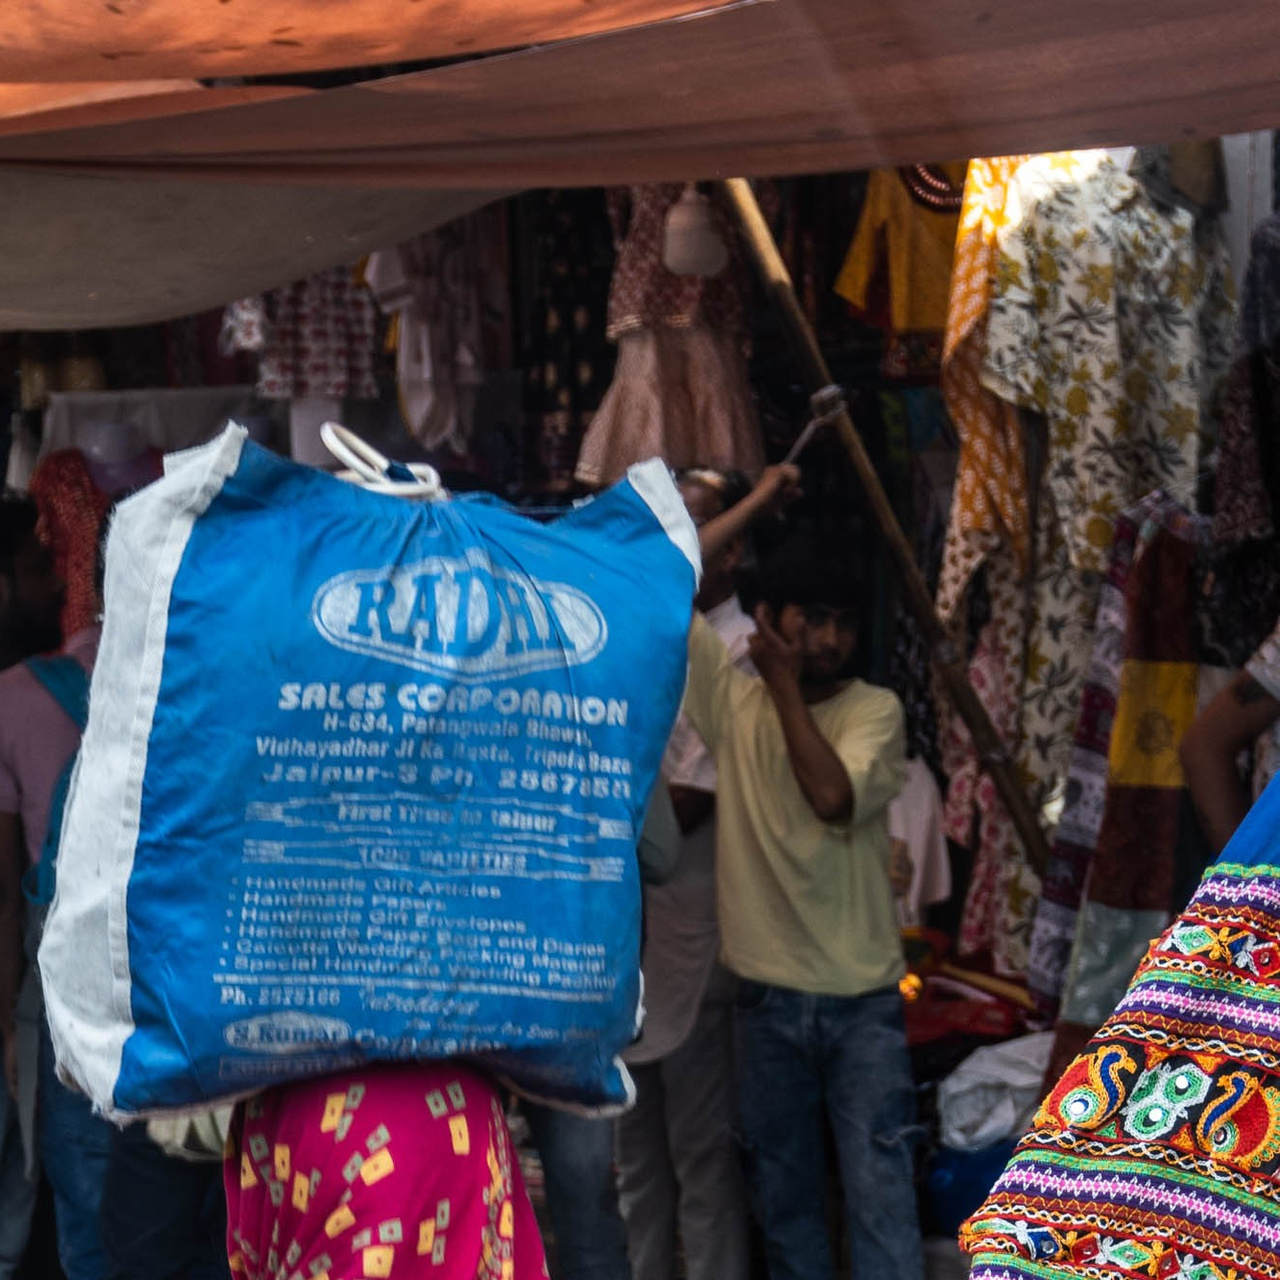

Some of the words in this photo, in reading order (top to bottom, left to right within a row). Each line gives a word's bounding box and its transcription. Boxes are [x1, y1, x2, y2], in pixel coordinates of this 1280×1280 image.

[278, 683, 386, 711] SALES
[398, 683, 628, 727] CORPORATION
[243, 890, 365, 907] Handmade
[246, 876, 366, 893] Handmade
[374, 876, 415, 893] Gift
[418, 879, 501, 899] Articles
[241, 906, 362, 923] Handmade
[369, 908, 409, 925] Gift
[415, 911, 527, 934] Envelopes
[238, 922, 360, 940] Handmade
[367, 925, 428, 945] Paper
[498, 936, 538, 952] and
[234, 954, 318, 973] Special
